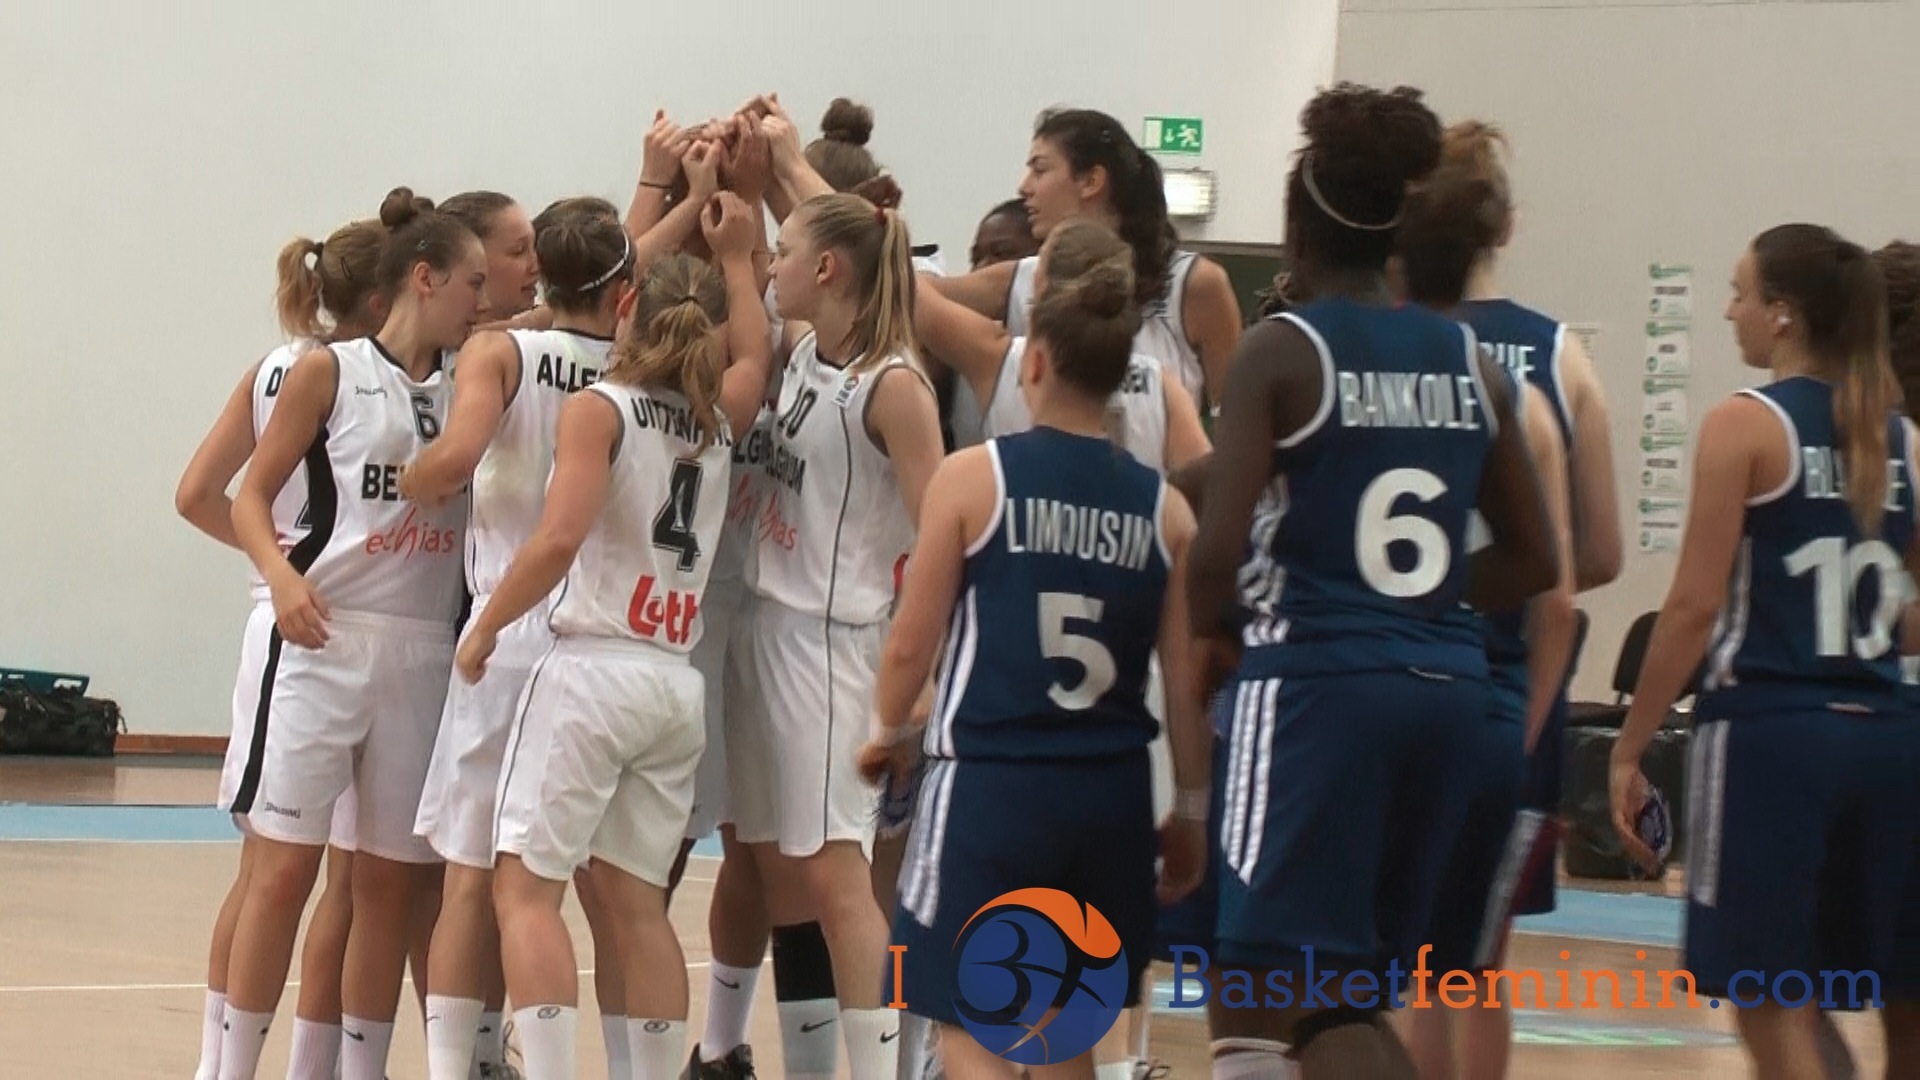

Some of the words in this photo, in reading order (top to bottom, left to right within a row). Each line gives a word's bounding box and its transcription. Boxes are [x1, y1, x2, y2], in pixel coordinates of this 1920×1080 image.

[537, 353, 608, 393] ALLE
[1337, 371, 1481, 431] BANKOLE
[410, 392, 440, 444] 6
[365, 501, 457, 560] ethias
[653, 457, 702, 573] 4
[1005, 496, 1155, 572] LIMOUSIN
[1353, 467, 1451, 598] 6
[1782, 537, 1912, 660] 10
[1036, 591, 1118, 711] 5
